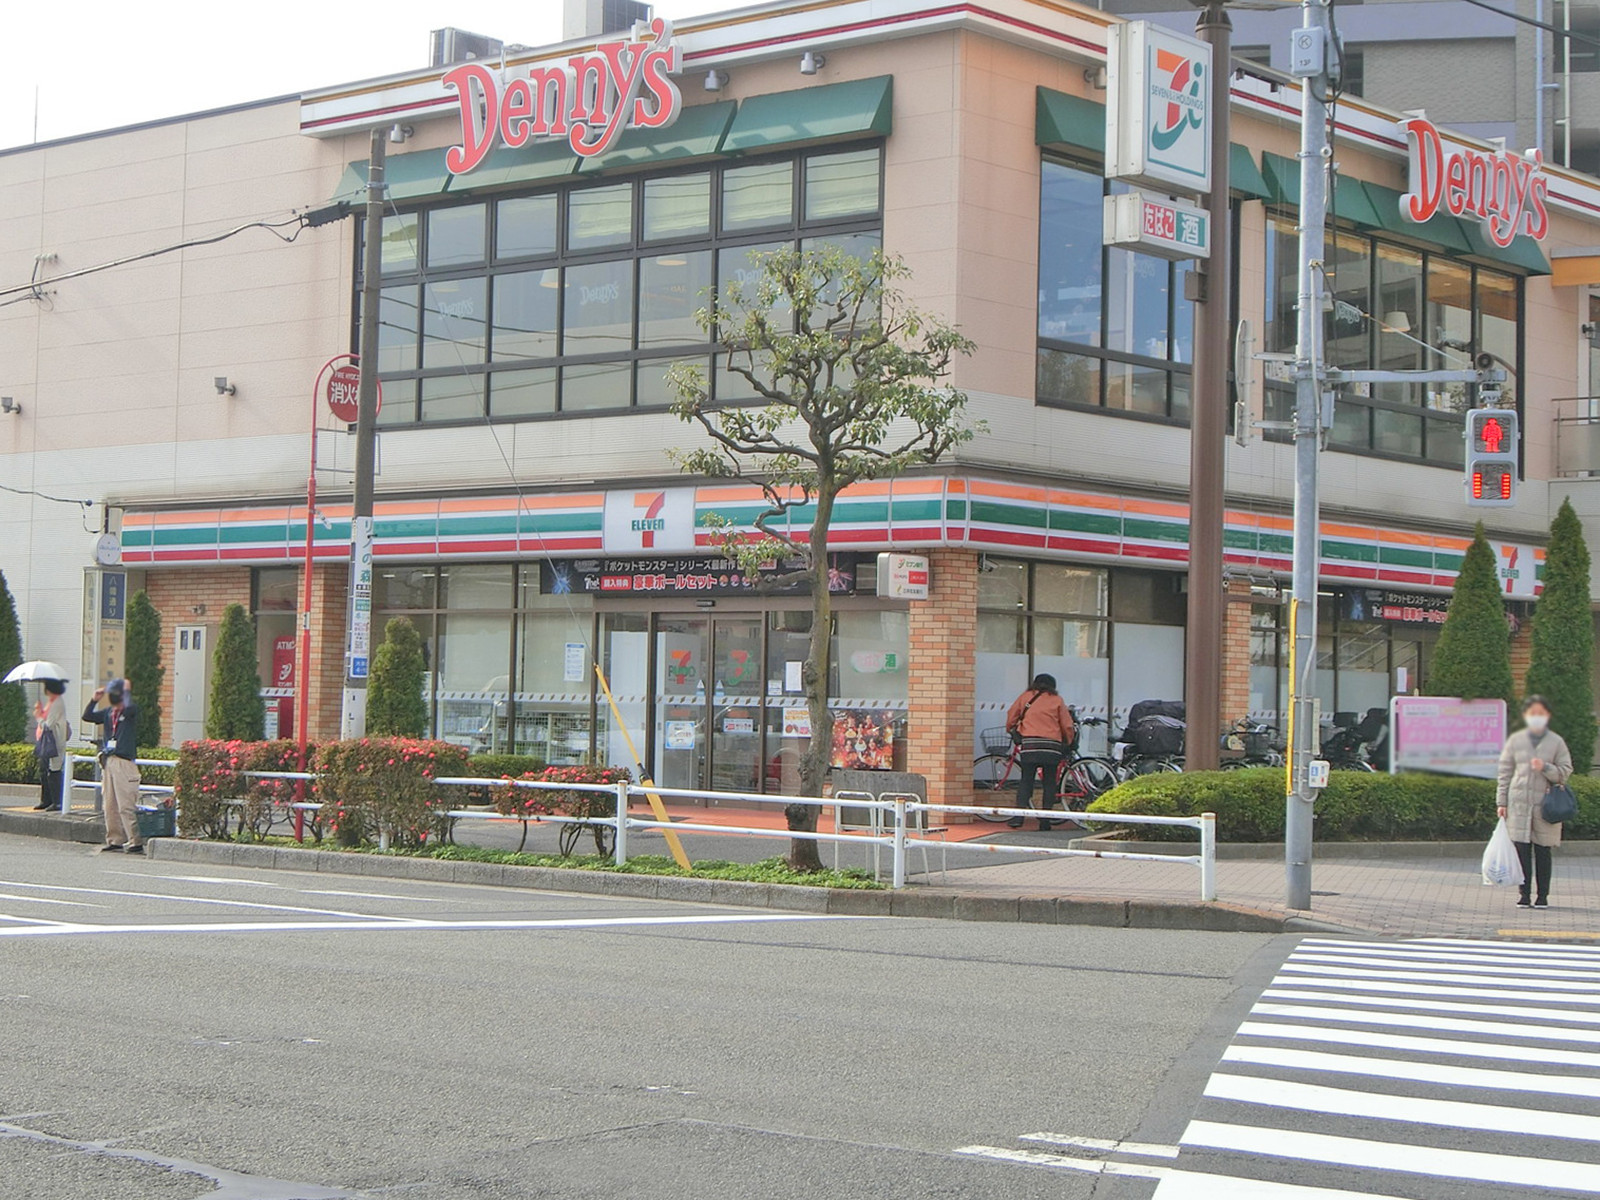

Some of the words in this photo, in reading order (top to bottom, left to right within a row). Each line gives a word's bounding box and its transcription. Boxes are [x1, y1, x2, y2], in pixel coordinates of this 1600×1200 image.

[442, 18, 681, 175] Denny's
[1145, 204, 1174, 239] たばこ
[1181, 213, 1199, 244] 酒
[1405, 118, 1548, 248] Denny's
[633, 574, 718, 590] 豪華ボールセット
